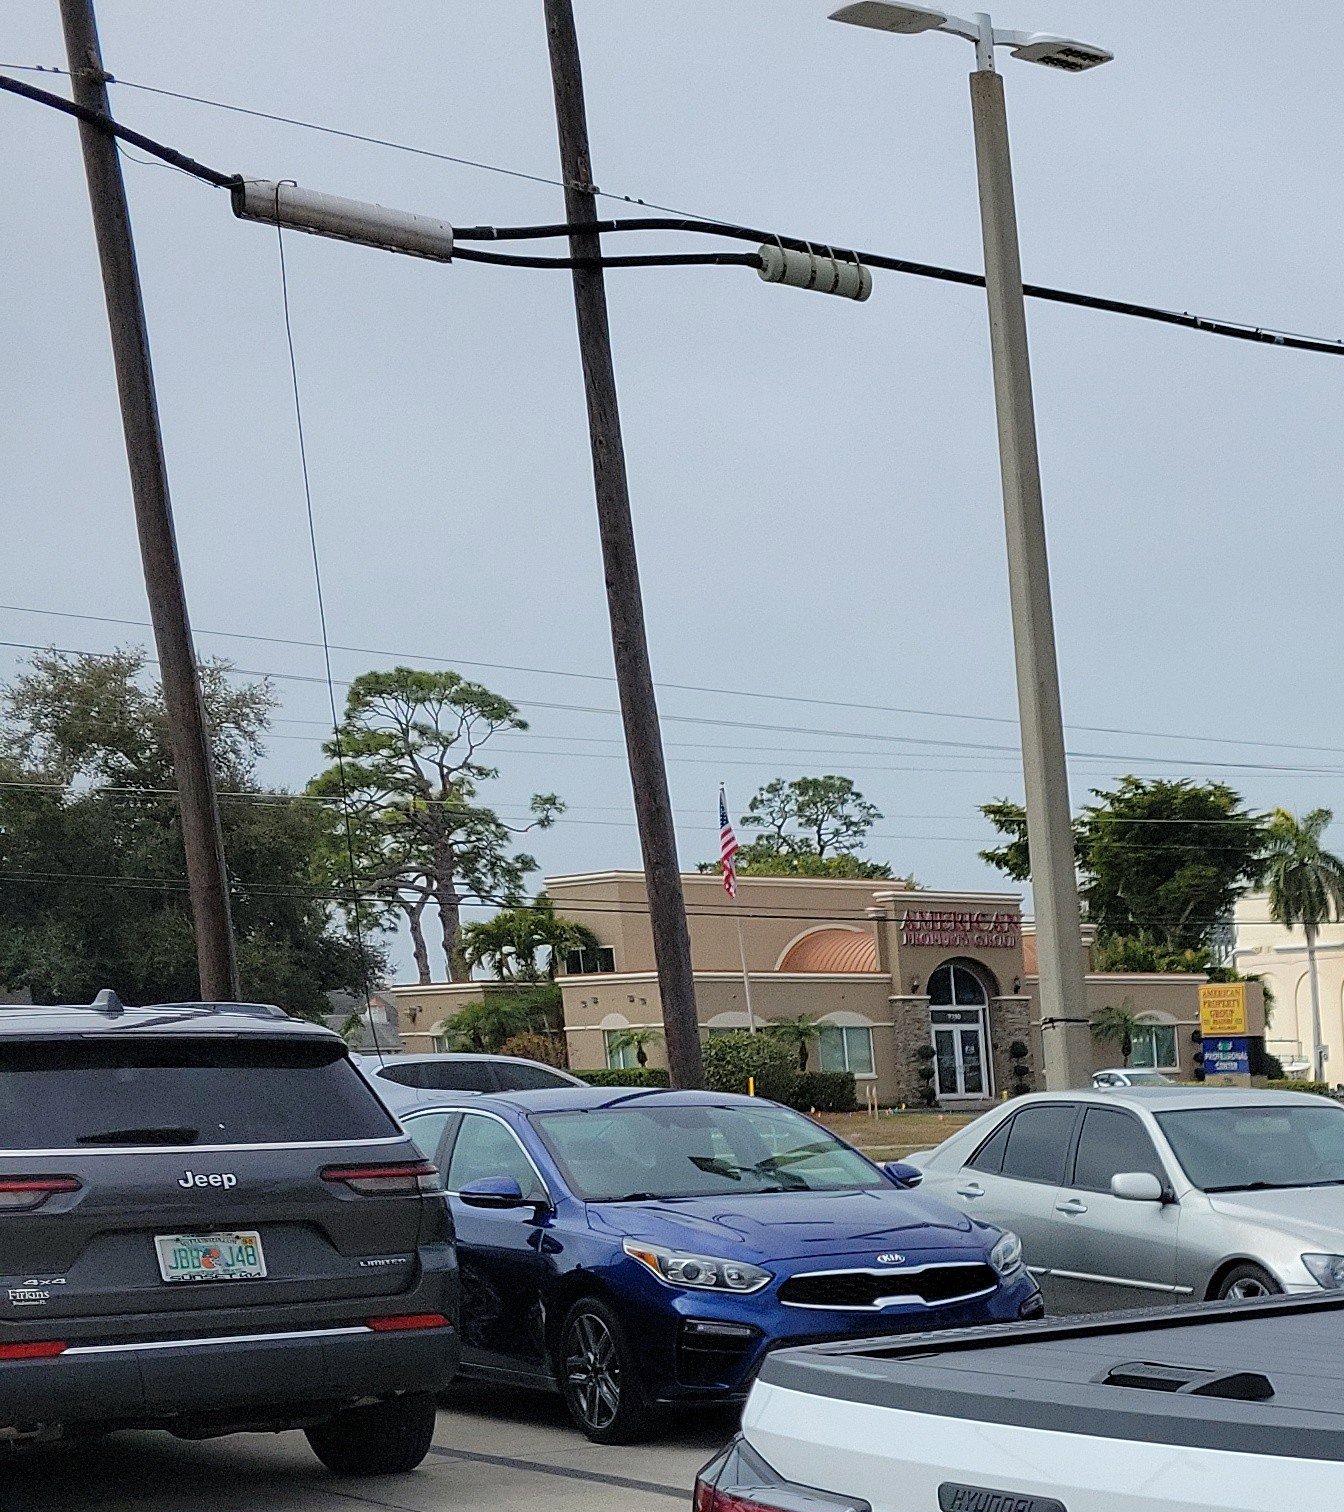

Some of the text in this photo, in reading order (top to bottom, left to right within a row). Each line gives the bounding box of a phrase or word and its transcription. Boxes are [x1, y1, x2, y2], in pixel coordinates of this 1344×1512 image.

[900, 909, 1022, 934] AMERICAN
[178, 1170, 237, 1190] Jeep
[22, 1278, 67, 1286] 4x4
[8, 1288, 50, 1300] Firkins
